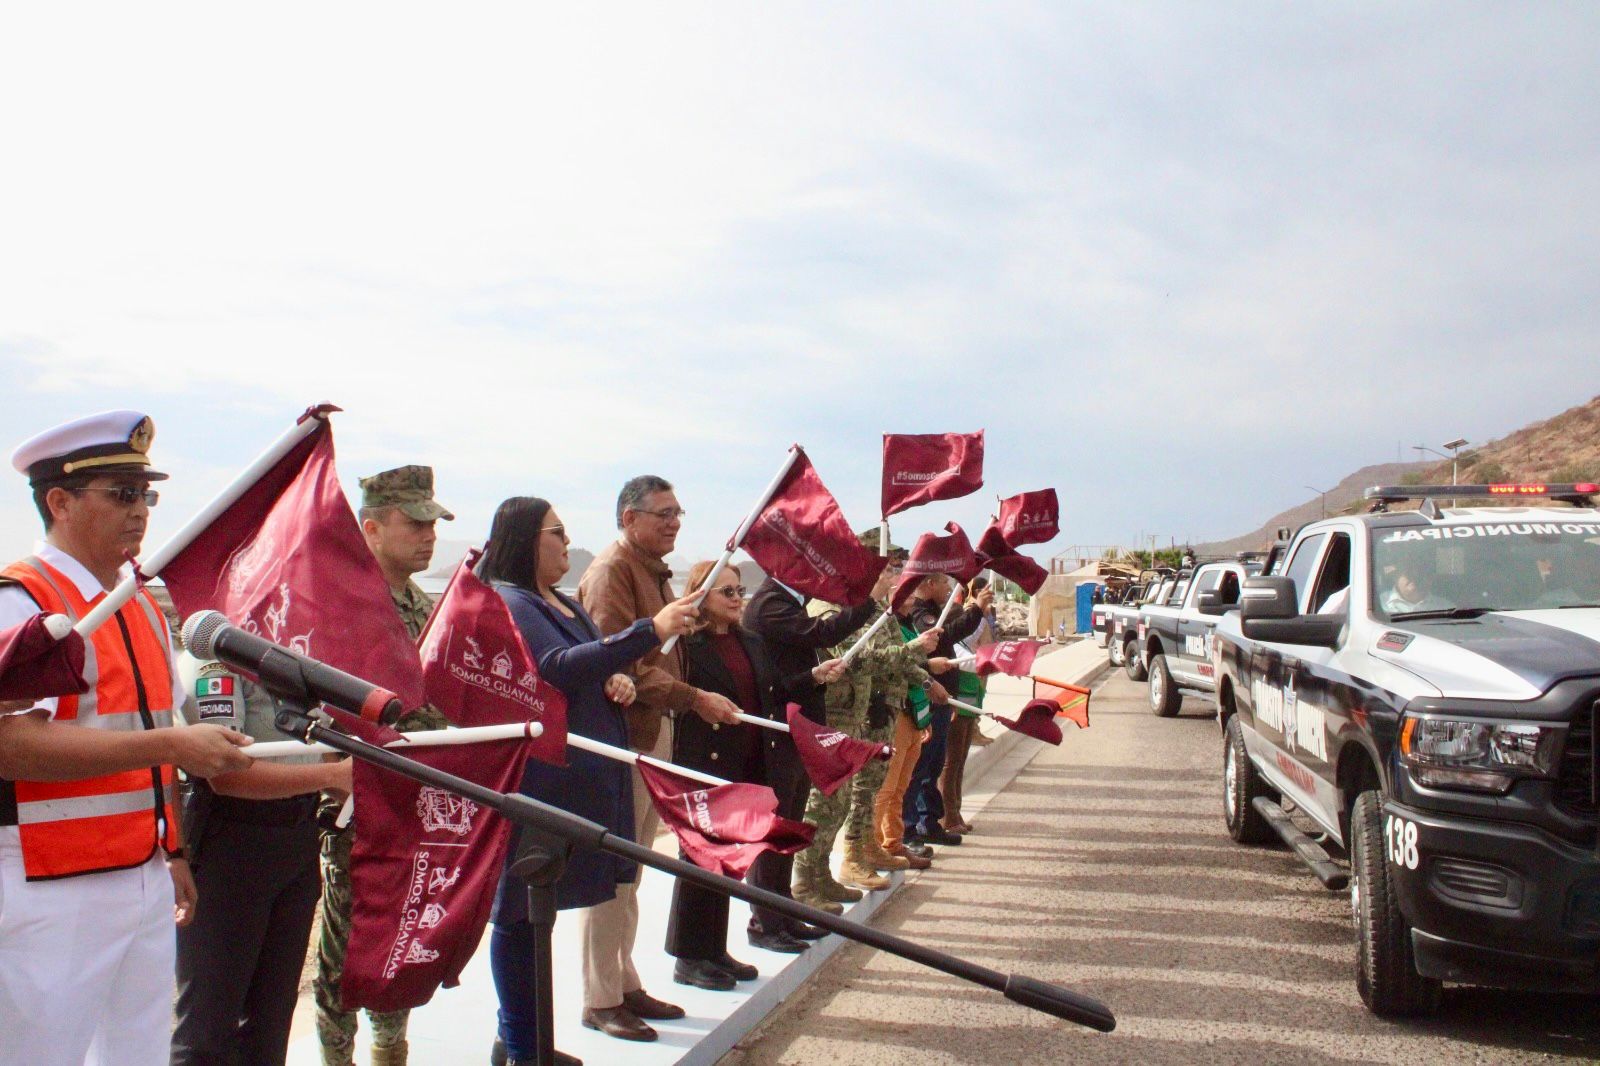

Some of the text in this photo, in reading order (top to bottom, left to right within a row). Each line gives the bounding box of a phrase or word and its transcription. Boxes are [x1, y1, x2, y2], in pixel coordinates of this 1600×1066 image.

[450, 663, 492, 687] SOMOS
[493, 680, 545, 712] GUAYMAS
[1385, 814, 1419, 870] 138
[409, 851, 429, 904] SOMOS
[386, 908, 419, 979] GUAYMAS
